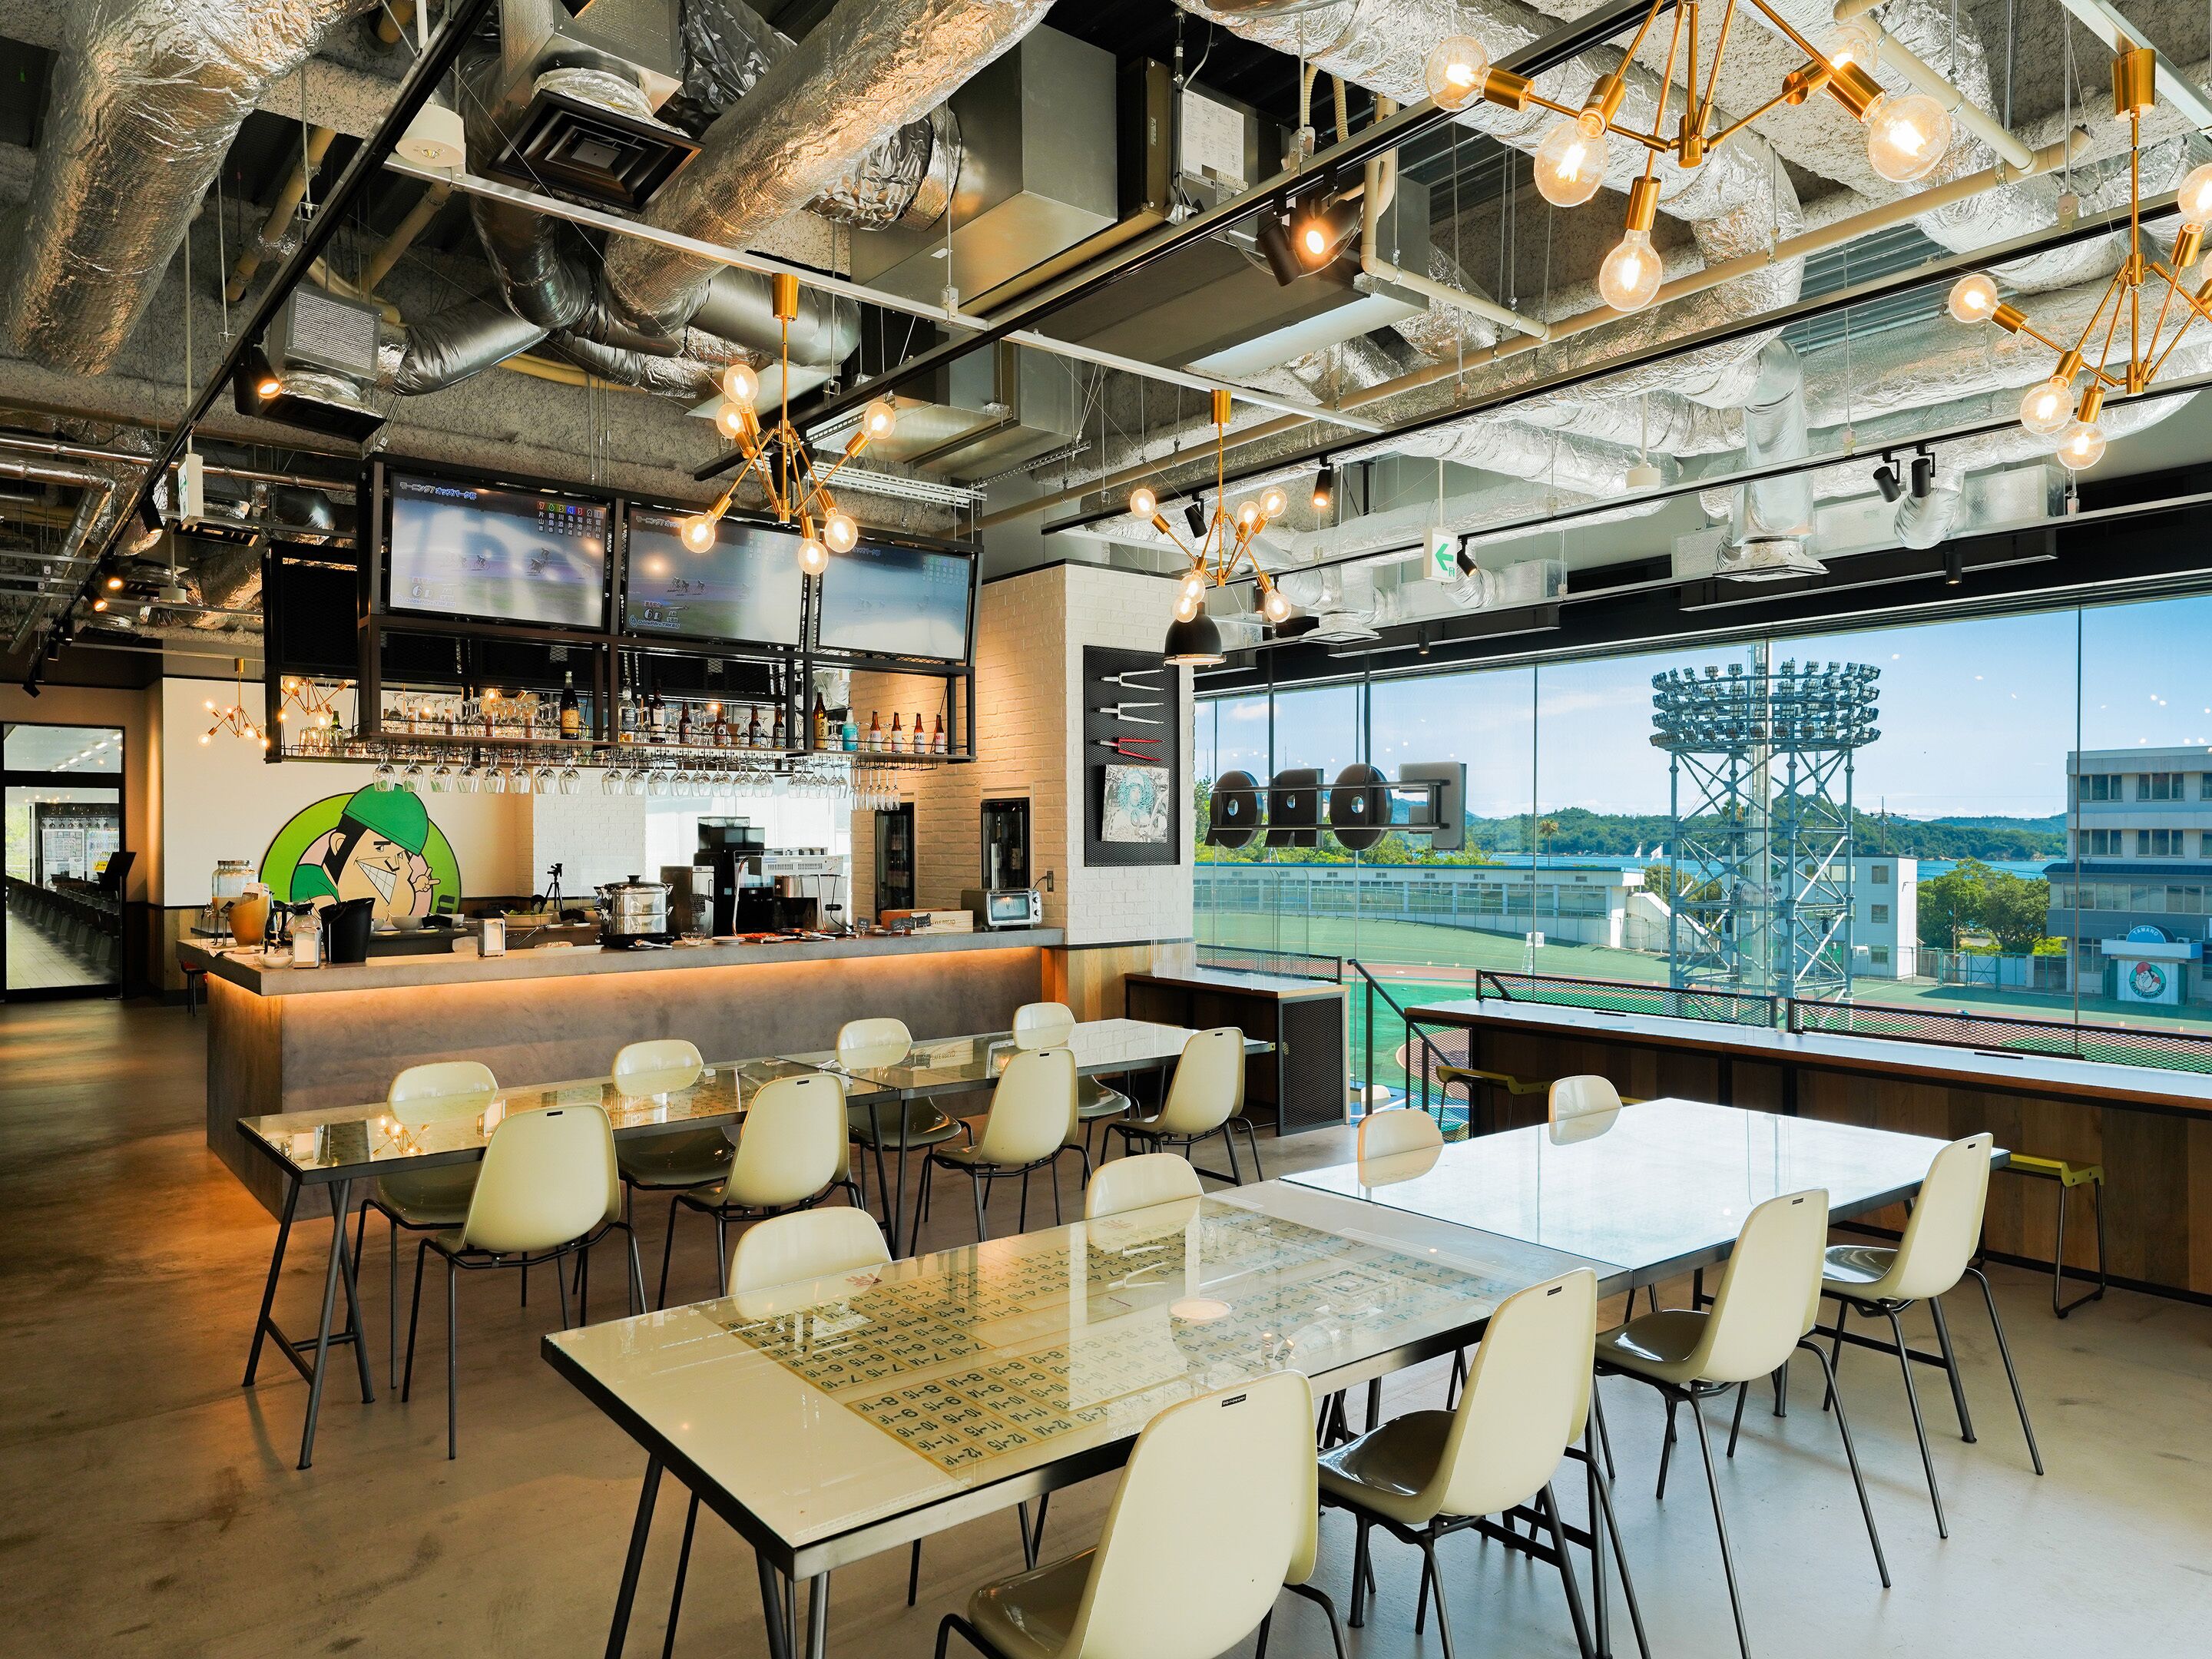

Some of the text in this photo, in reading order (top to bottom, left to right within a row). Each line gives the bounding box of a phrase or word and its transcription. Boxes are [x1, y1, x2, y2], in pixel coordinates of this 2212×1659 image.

[2133, 927, 2159, 936] TAMANO
[890, 1343, 926, 1355] 6-14
[848, 1353, 885, 1366] 6-15
[908, 1353, 946, 1366] 7-14
[866, 1363, 904, 1377] 7-15
[988, 1362, 1025, 1375] 8-13
[821, 1374, 863, 1388] 7-16
[945, 1373, 984, 1386] 8-14
[902, 1385, 942, 1399] 8-15
[965, 1384, 1004, 1398] 9-14
[922, 1396, 961, 1411] 9-15
[987, 1395, 1025, 1409] 10-14
[942, 1408, 982, 1423] 10-15
[1008, 1407, 1048, 1422] 11-14
[896, 1420, 938, 1437] 10-16
[963, 1420, 1003, 1436] 11-15
[1032, 1419, 1071, 1435] 12-14
[918, 1434, 959, 1450] 11-16
[987, 1432, 1027, 1450] 12-15
